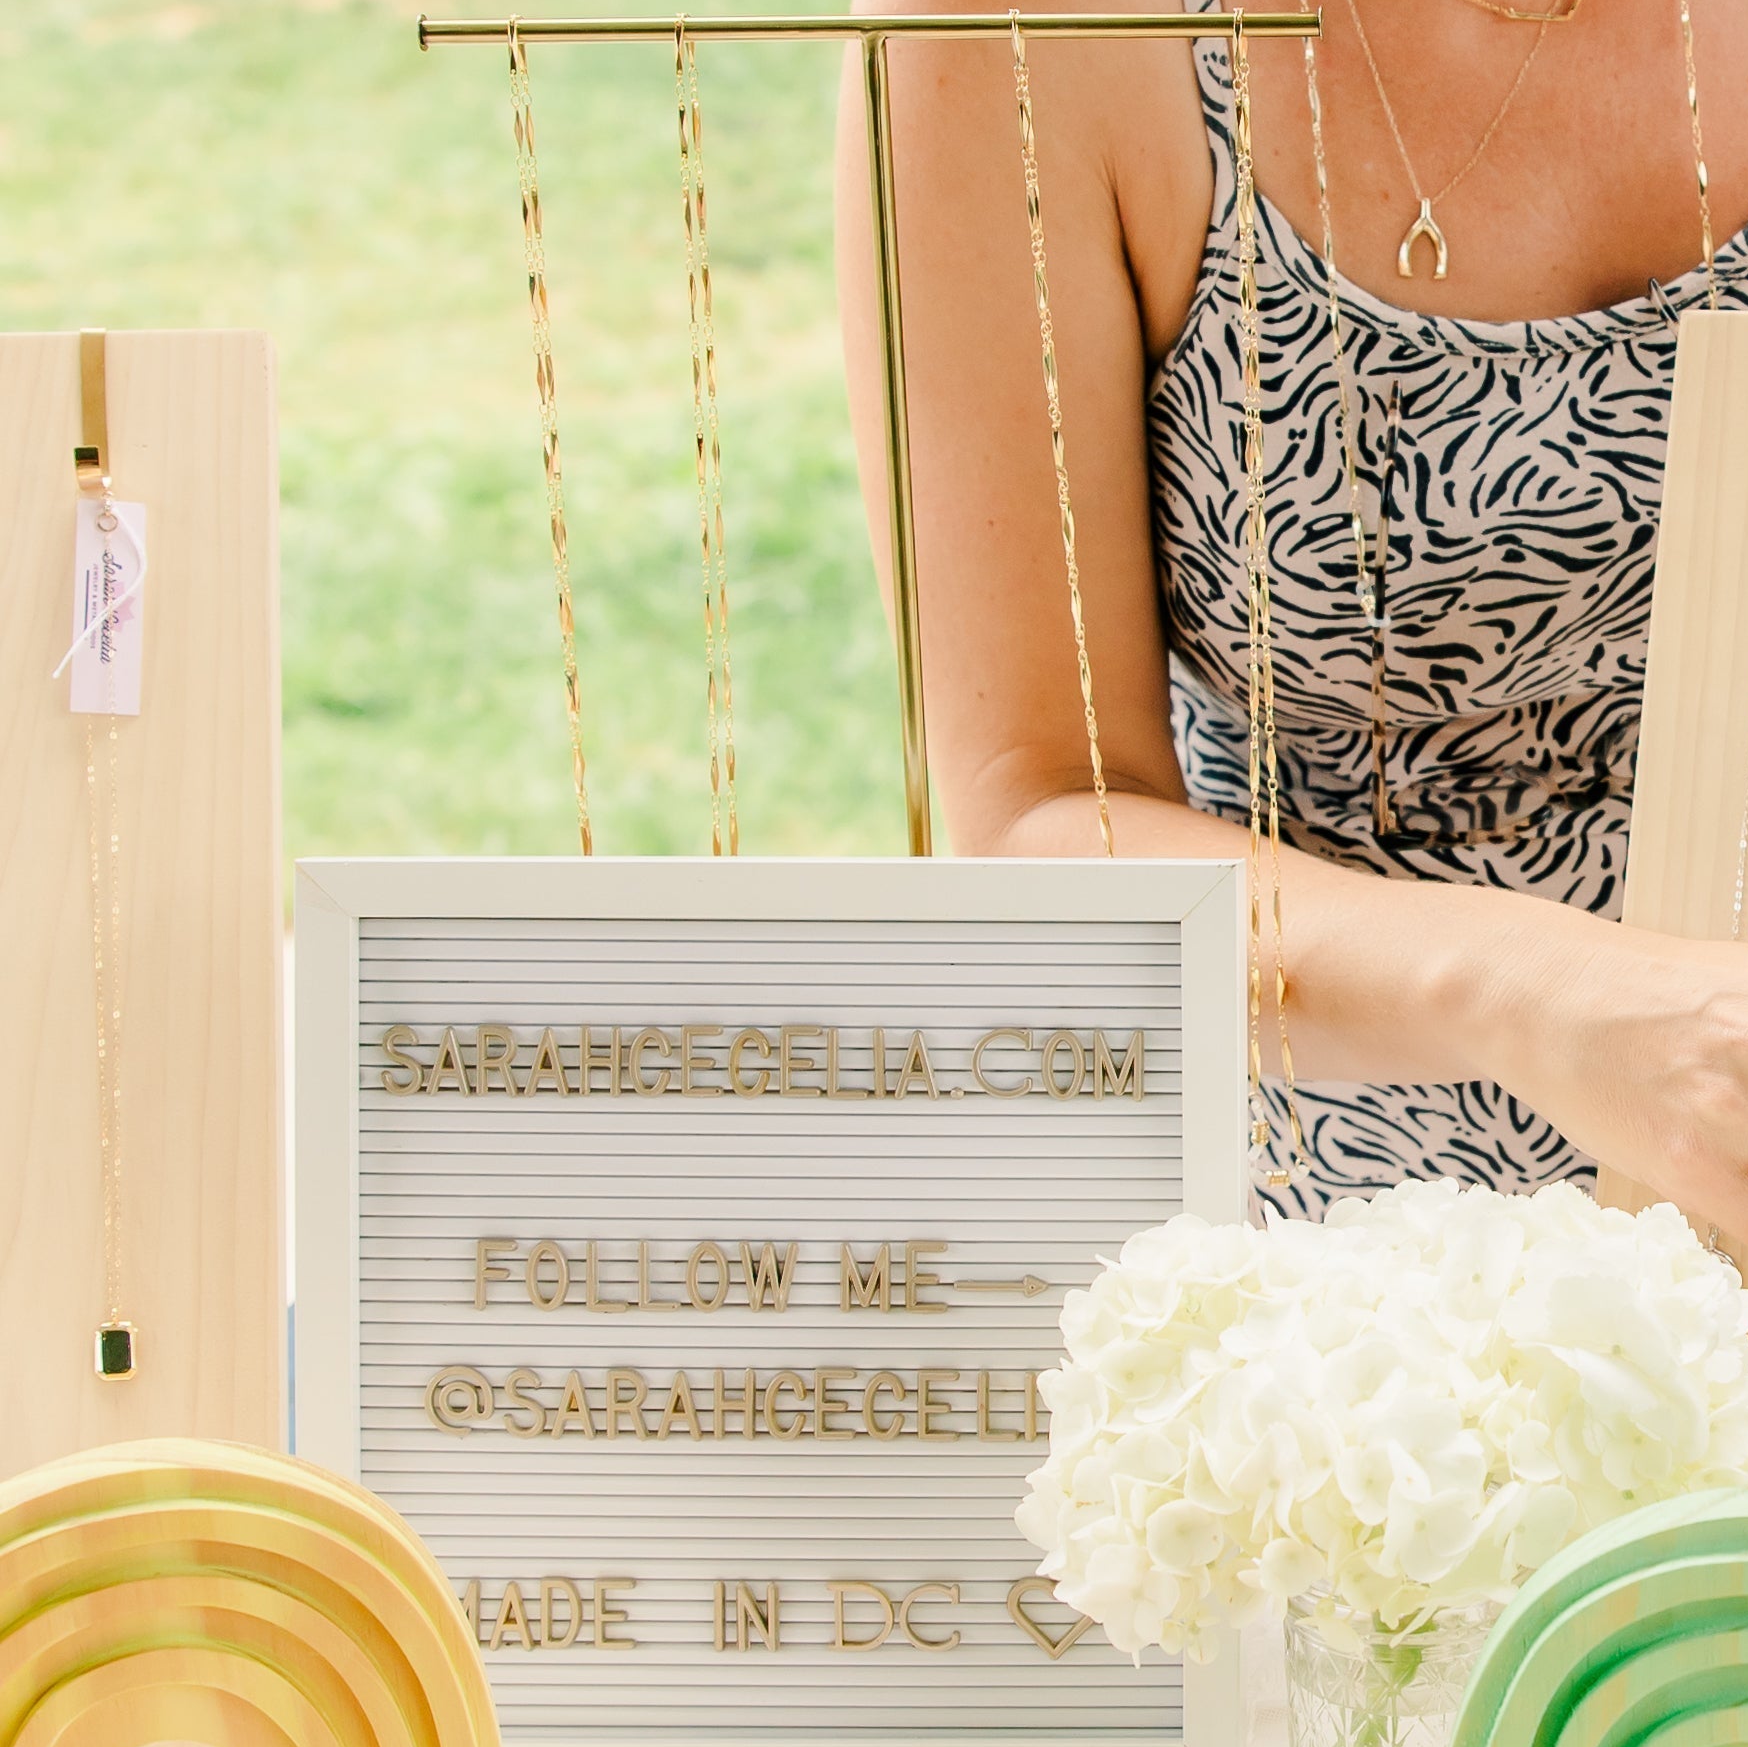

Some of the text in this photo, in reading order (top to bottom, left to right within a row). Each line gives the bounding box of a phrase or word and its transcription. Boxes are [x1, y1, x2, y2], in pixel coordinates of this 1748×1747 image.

[381, 1024, 1145, 1103] SARAHCECELIA.COM
[473, 1239, 950, 1314] FOLLOW ME
[424, 1365, 1048, 1442] @SARAHCECELI
[714, 1580, 780, 1653] IN
[827, 1579, 963, 1653] DC
